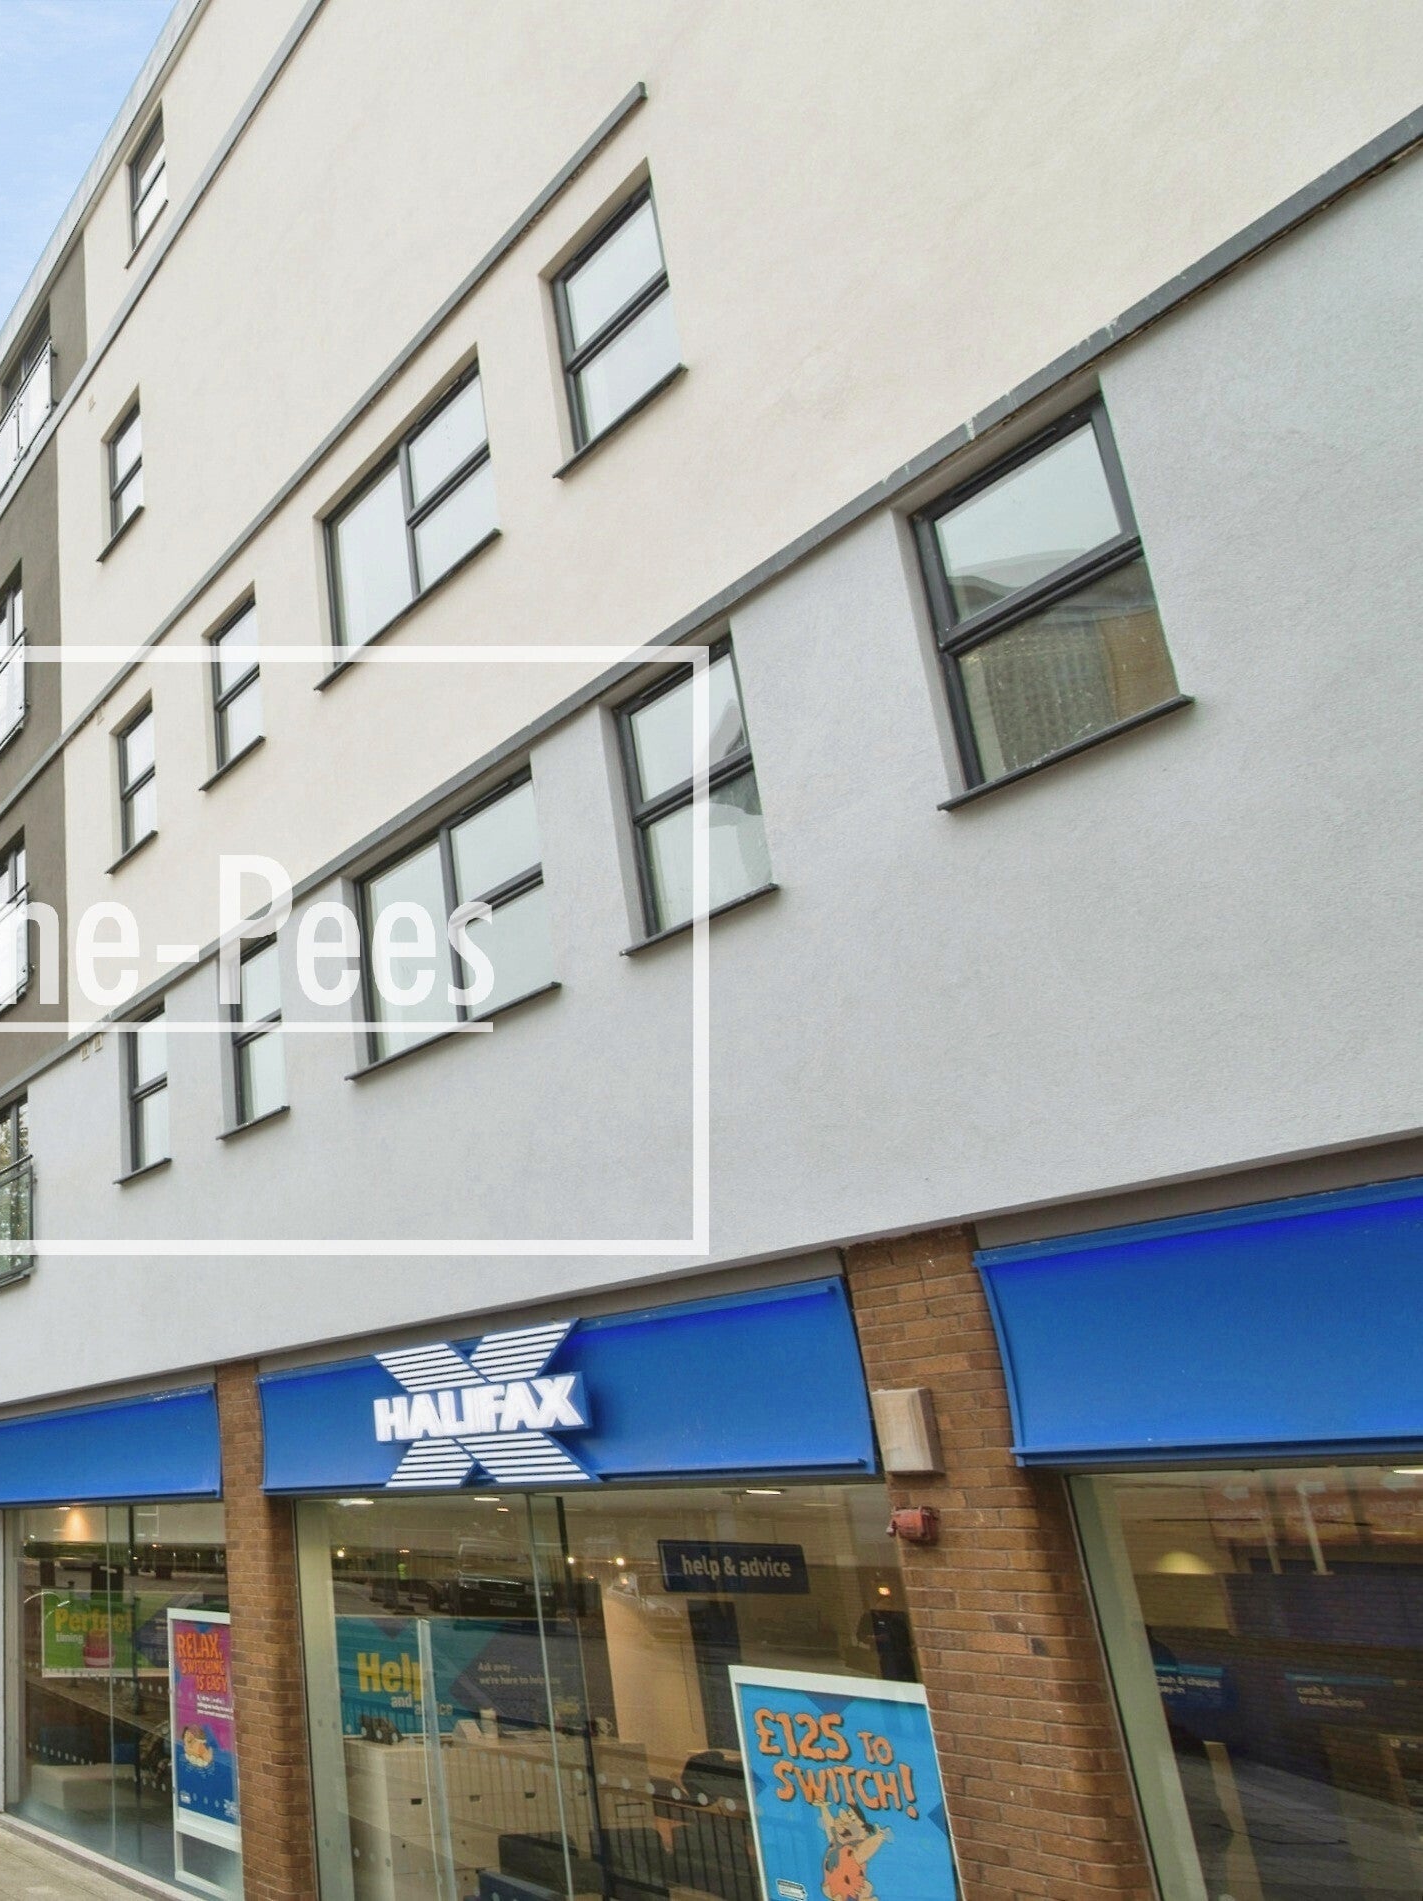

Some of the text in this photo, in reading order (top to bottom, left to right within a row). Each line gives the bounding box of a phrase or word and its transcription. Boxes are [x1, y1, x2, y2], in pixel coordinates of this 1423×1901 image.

[373, 1374, 586, 1442] HALIFAX
[681, 1554, 791, 1580] help & advice
[56, 1632, 84, 1646] timing
[176, 1632, 223, 1659] RELAX,
[206, 1675, 228, 1692] EASY
[390, 1693, 413, 1709] and
[753, 1708, 895, 1766] £125 TO
[773, 1760, 919, 1820] SWITCH!
